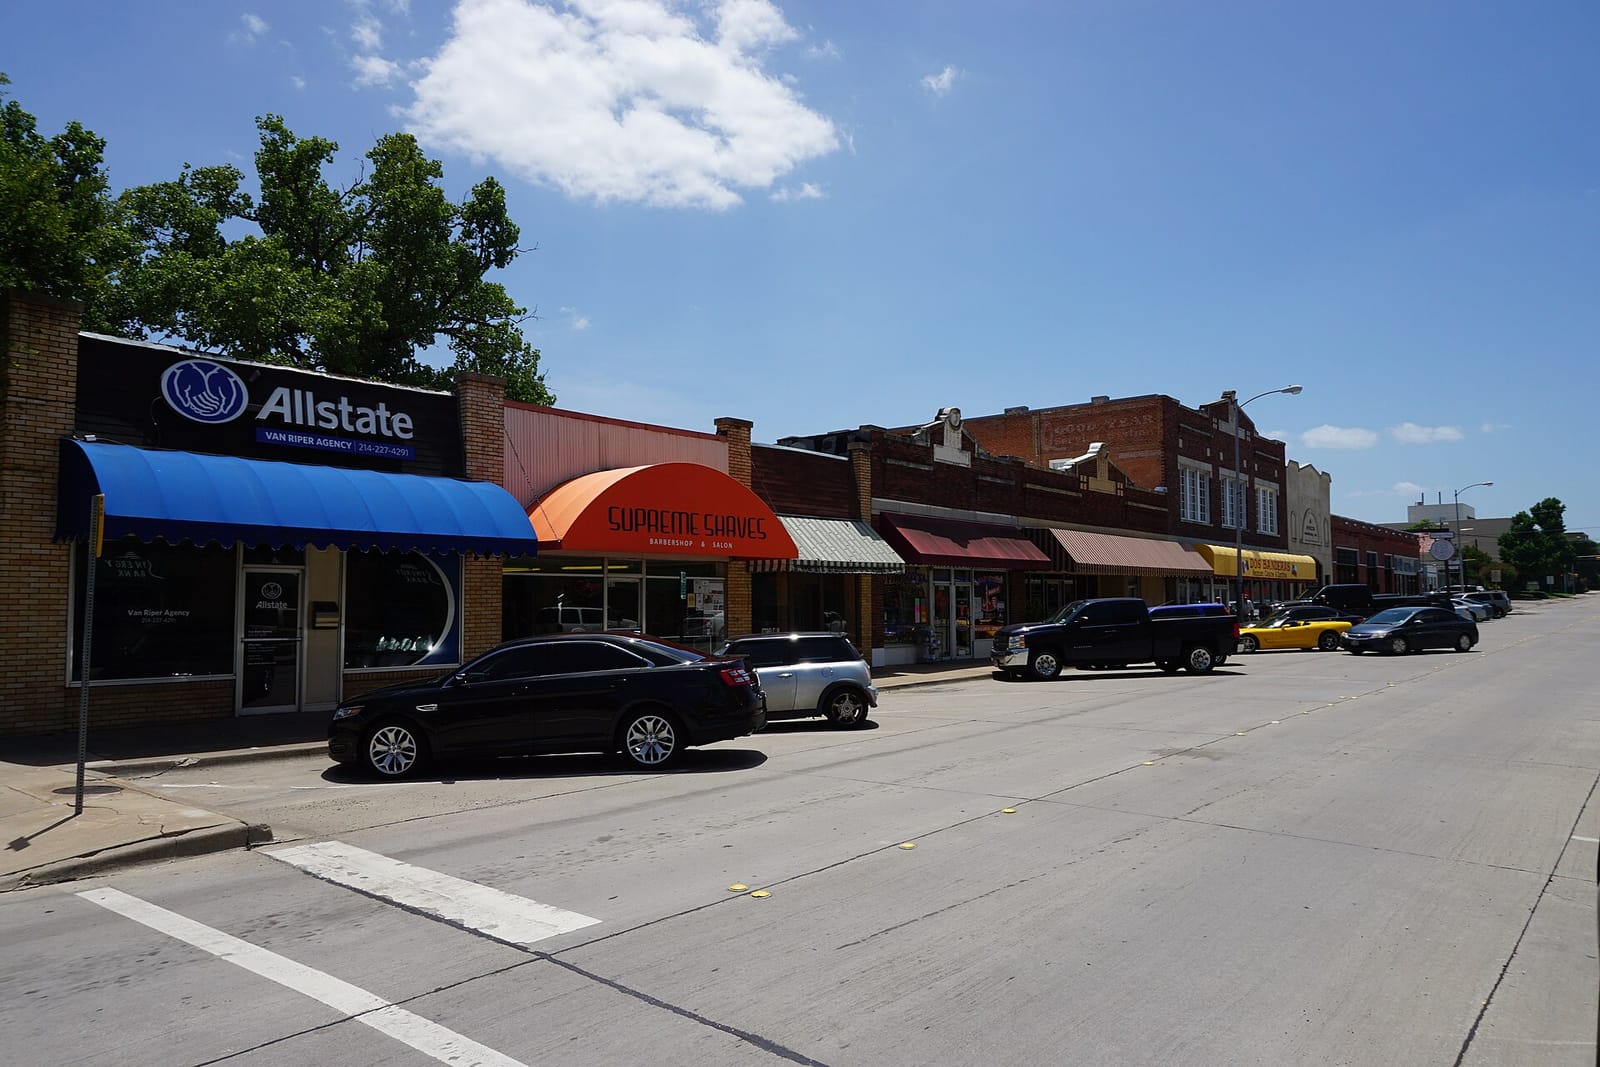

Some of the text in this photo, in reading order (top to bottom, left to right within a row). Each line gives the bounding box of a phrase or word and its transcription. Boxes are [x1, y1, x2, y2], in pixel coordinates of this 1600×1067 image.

[255, 386, 414, 440] Allstate
[265, 431, 409, 457] VAN RIPER AGENCY 214-227-4291
[608, 506, 767, 539] SUPREME SHAVES
[649, 537, 693, 547] BARBERSHOP
[712, 541, 733, 549] SALON
[127, 608, 190, 618] Van Riper Agency
[256, 600, 288, 609] Allstate
